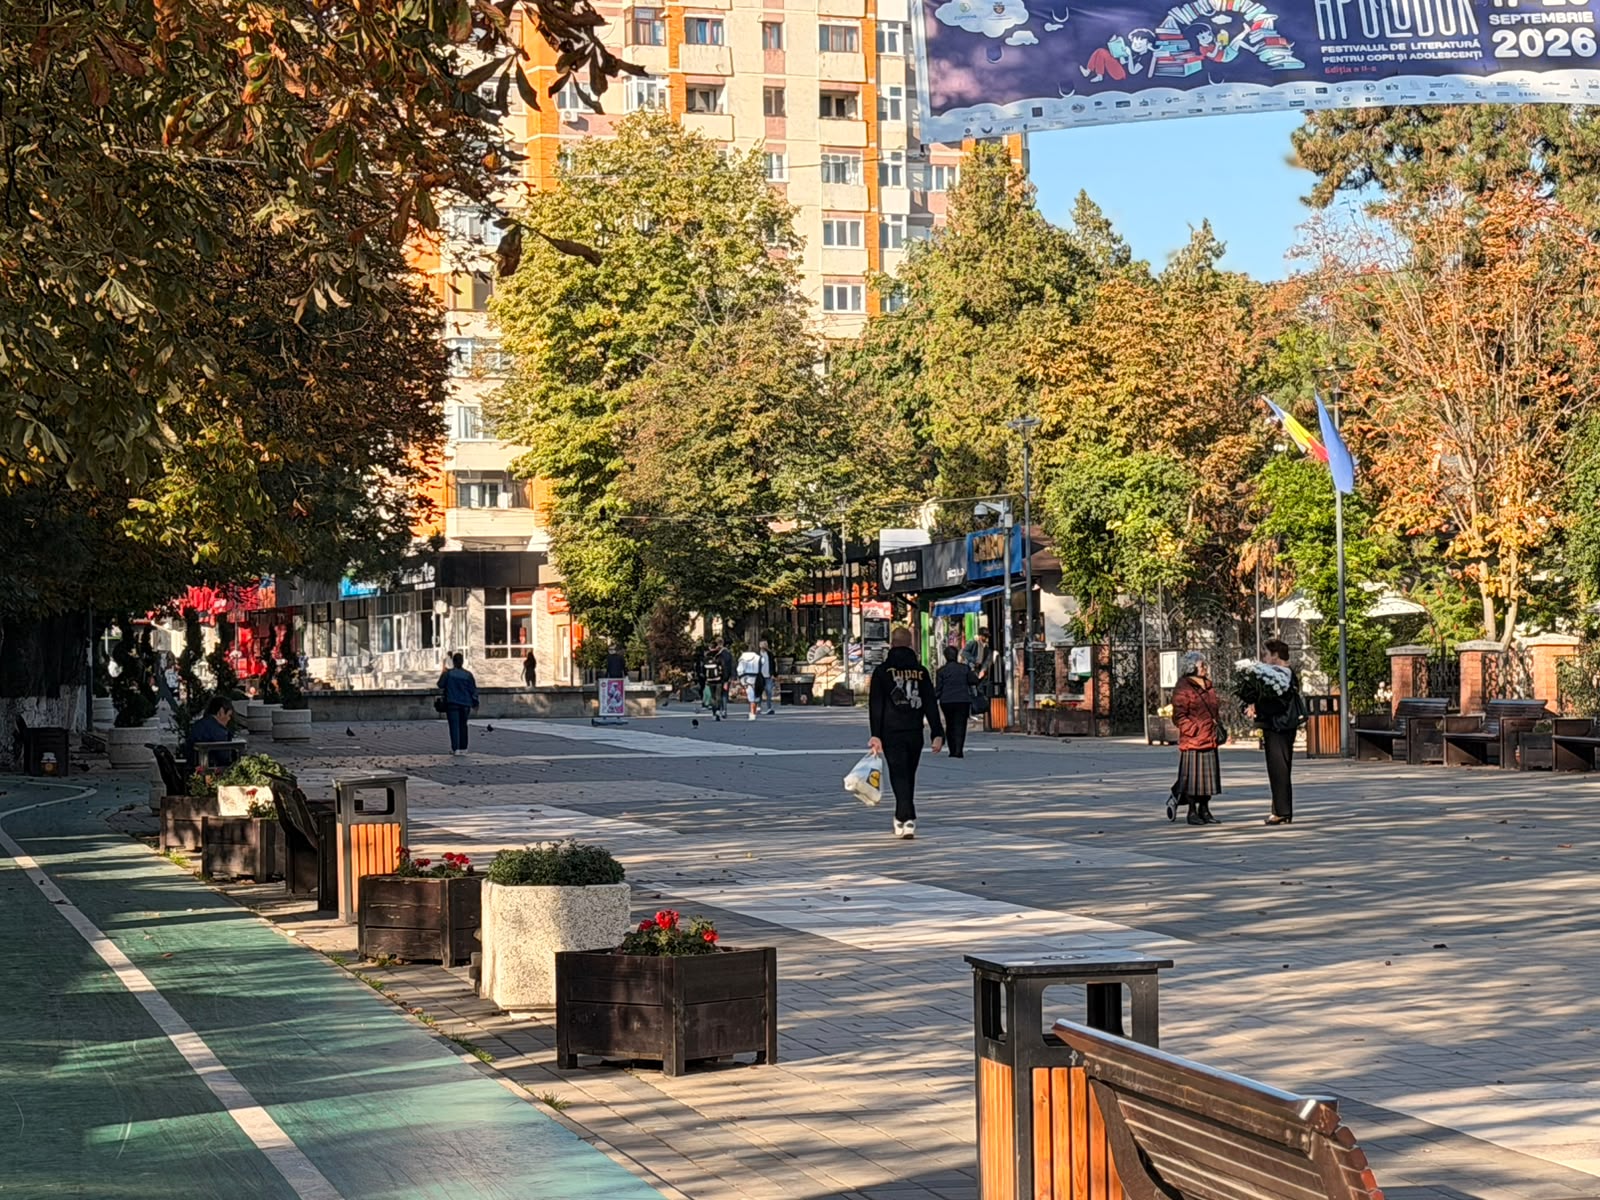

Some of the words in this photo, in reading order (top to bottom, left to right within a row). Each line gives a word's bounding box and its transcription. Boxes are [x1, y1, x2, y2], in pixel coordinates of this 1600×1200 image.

[1488, 11, 1594, 25] SEPTEMBRIE
[1321, 43, 1388, 53] FESTIVALUL
[1390, 43, 1406, 51] DE
[1492, 27, 1597, 58] 2026
[1322, 54, 1365, 63] PENTRU
[1367, 53, 1395, 62] COPII
[1409, 51, 1483, 61] ADOLESCENȚI
[886, 668, 923, 681] Tupac
